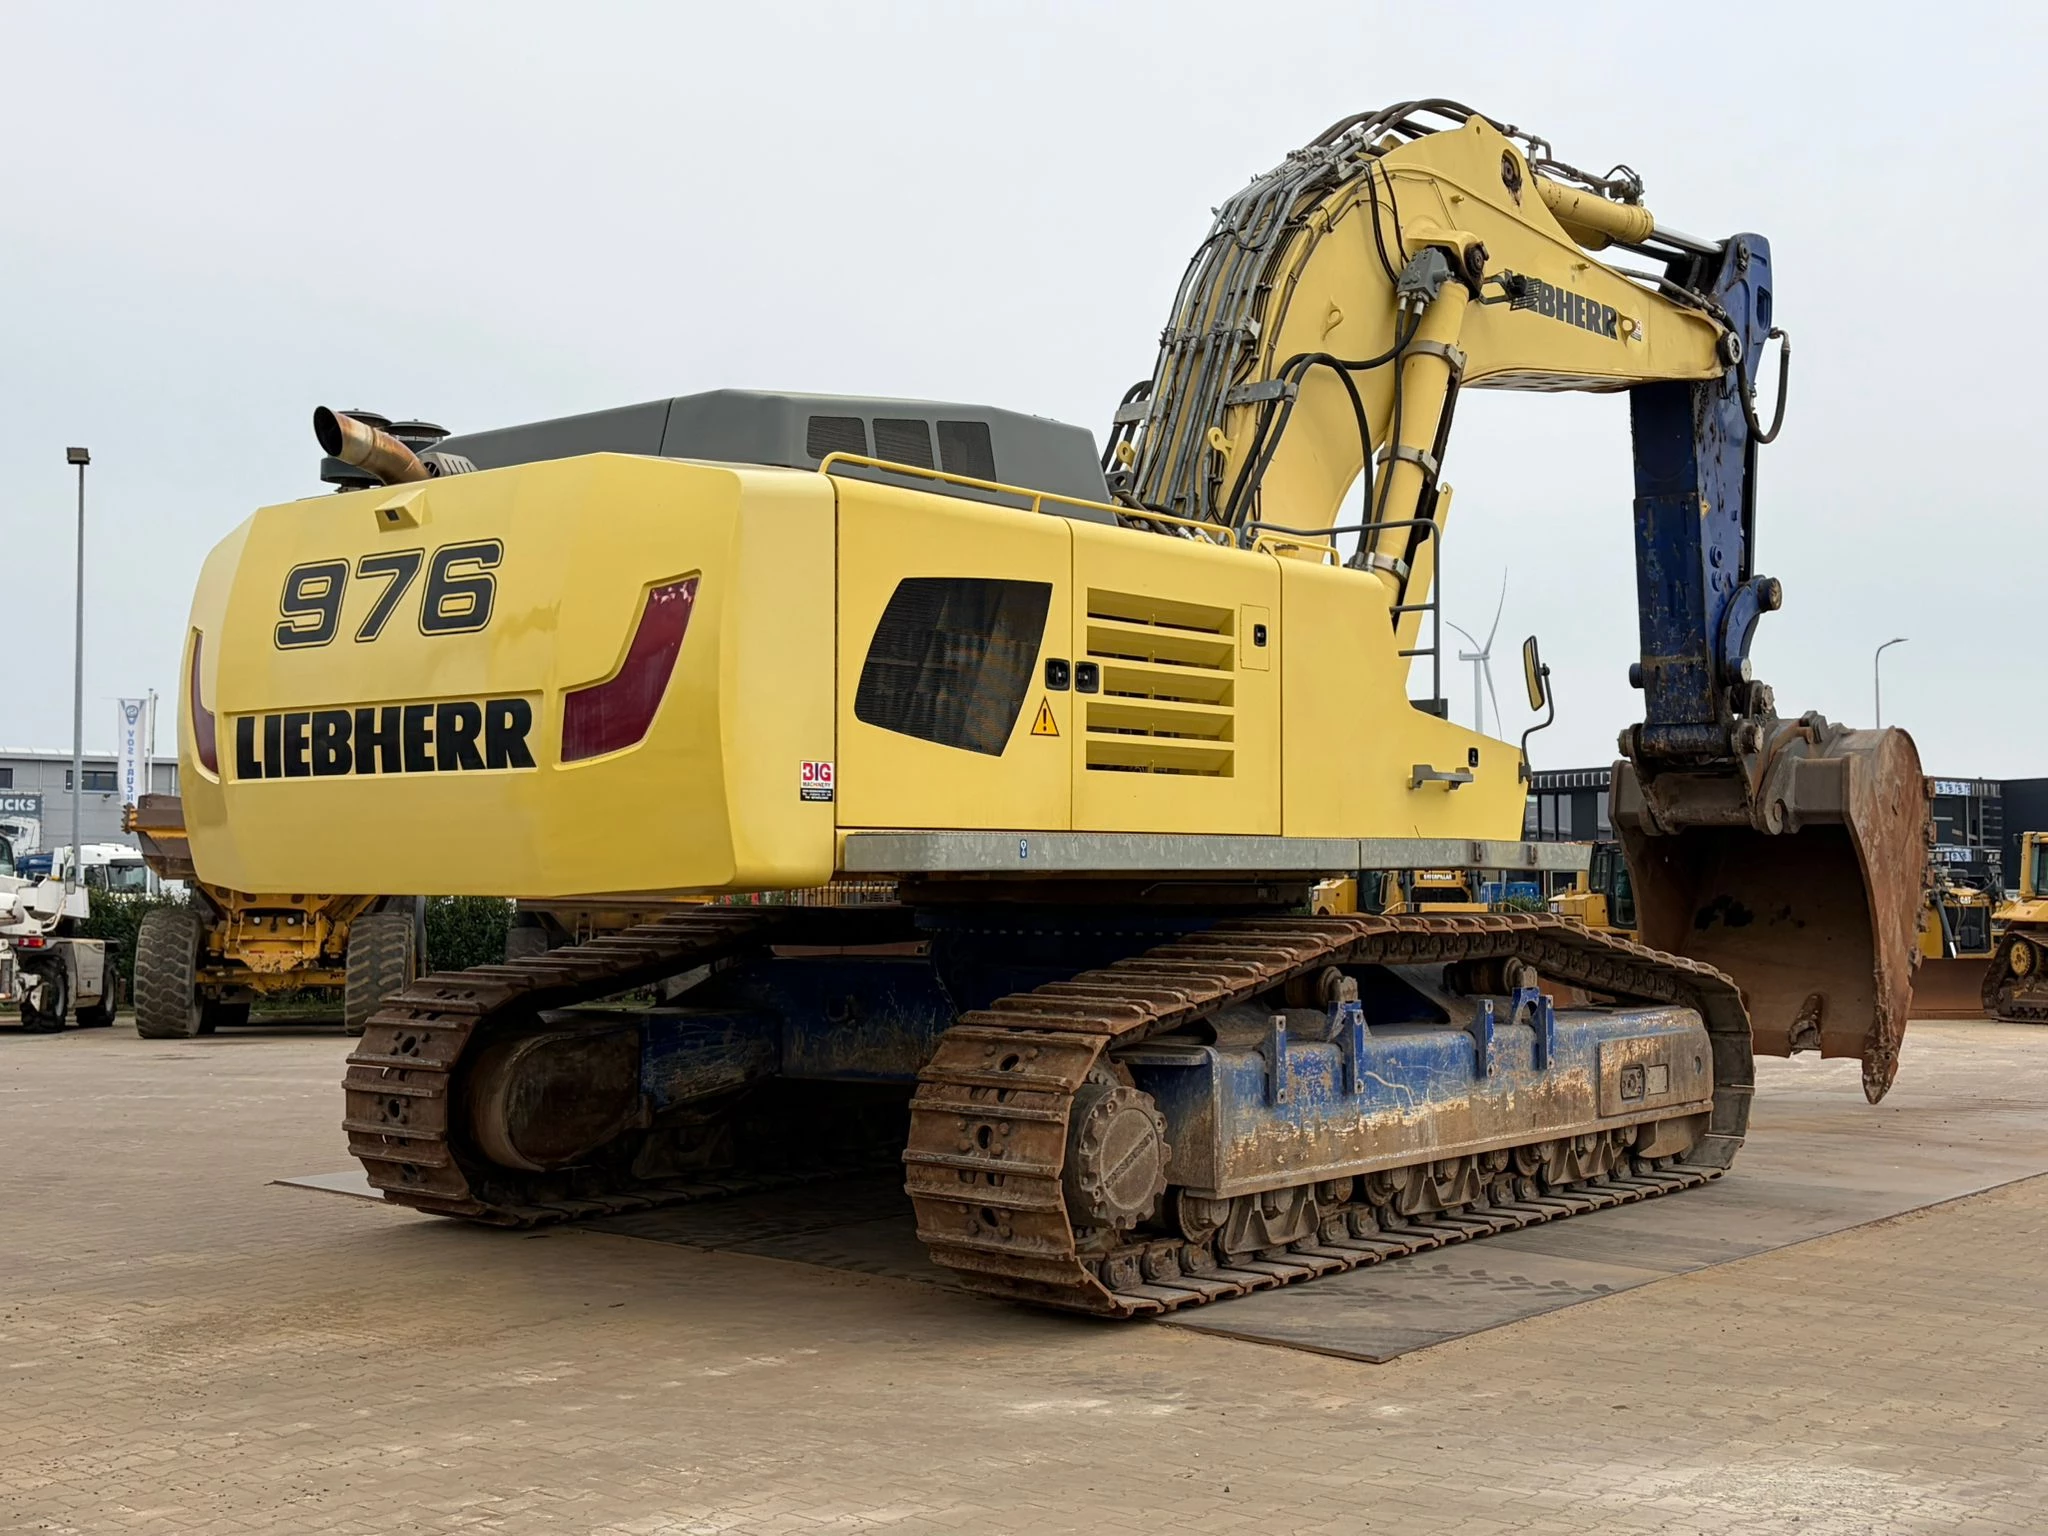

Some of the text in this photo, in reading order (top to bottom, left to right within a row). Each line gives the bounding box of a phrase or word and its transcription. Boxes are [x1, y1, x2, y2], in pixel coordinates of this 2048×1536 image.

[1505, 268, 1618, 341] BHERR
[274, 538, 504, 651] 976
[236, 698, 538, 780] LIEBHERR
[802, 762, 832, 782] BIG
